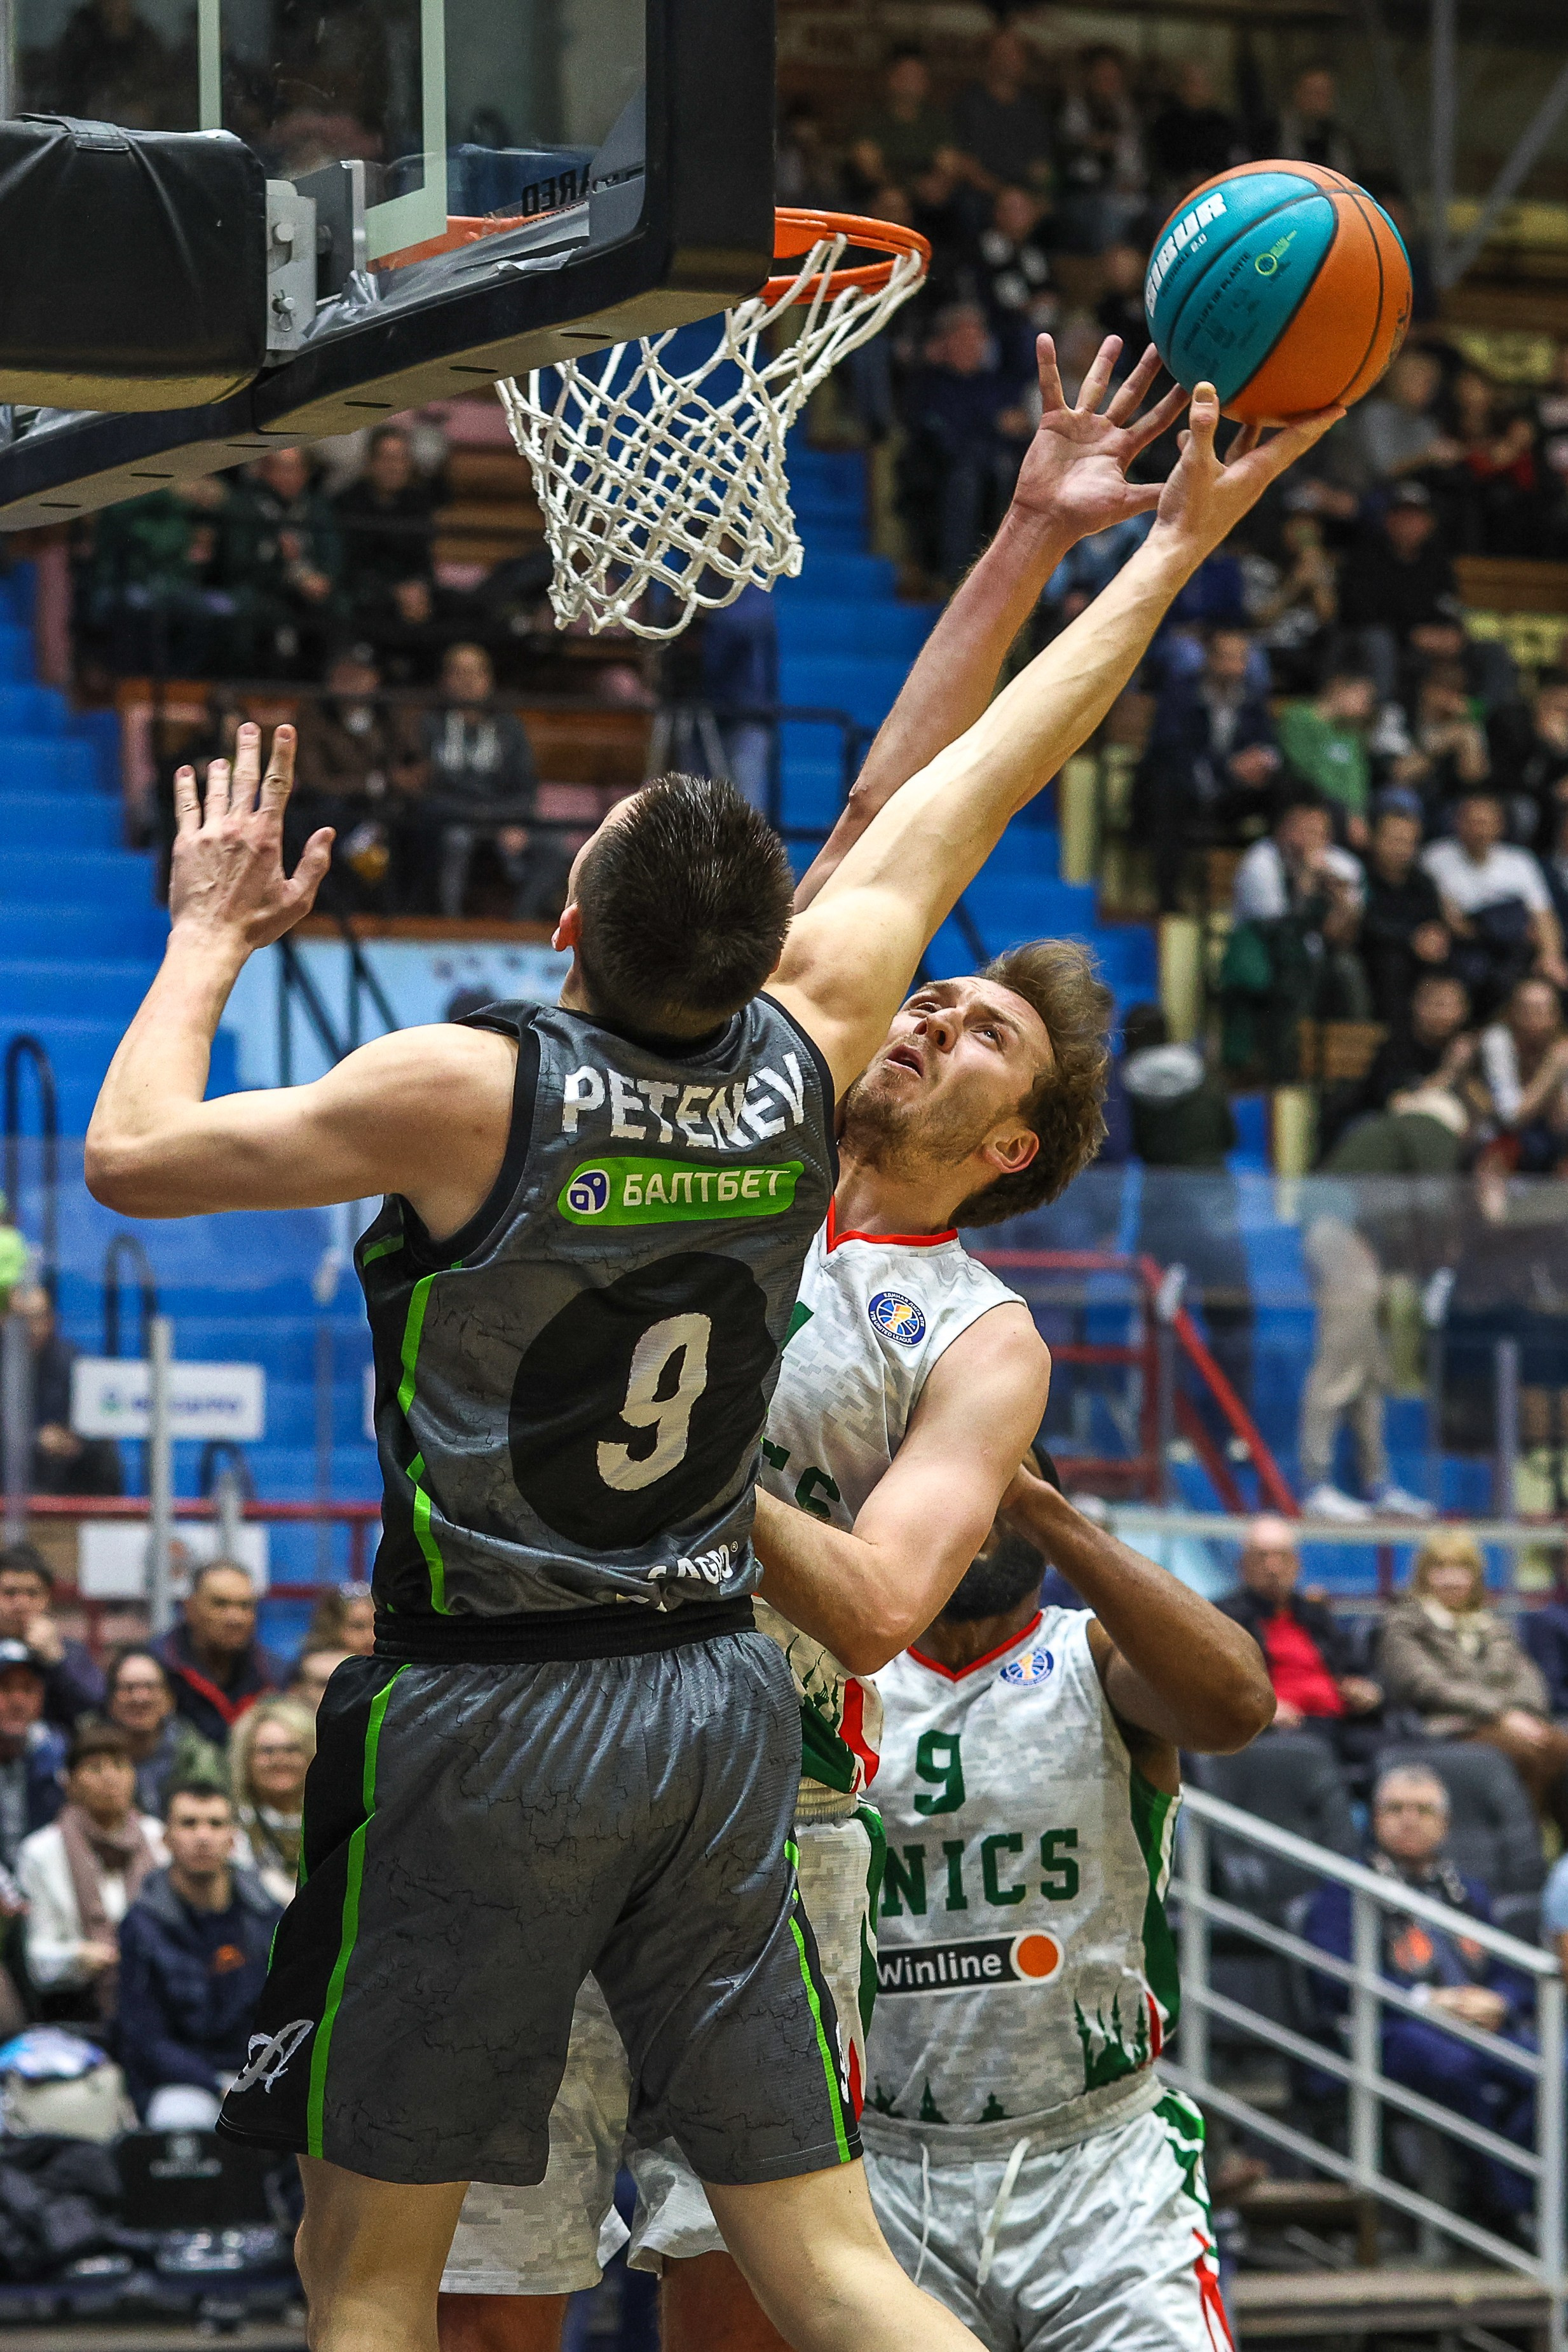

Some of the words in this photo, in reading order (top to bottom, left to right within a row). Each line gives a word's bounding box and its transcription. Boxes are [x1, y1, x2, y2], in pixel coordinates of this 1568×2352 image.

[1146, 193, 1227, 318] SIBUR
[624, 1170, 791, 1207] БАЛТБЕТ
[883, 1293, 909, 1303] ЕДИНАЯ
[908, 1301, 922, 1316] ЛИГА
[873, 1321, 892, 1336] UNITED
[597, 1313, 712, 1491] 9
[913, 1729, 965, 1815] 9
[876, 1951, 1002, 1987] Winline
